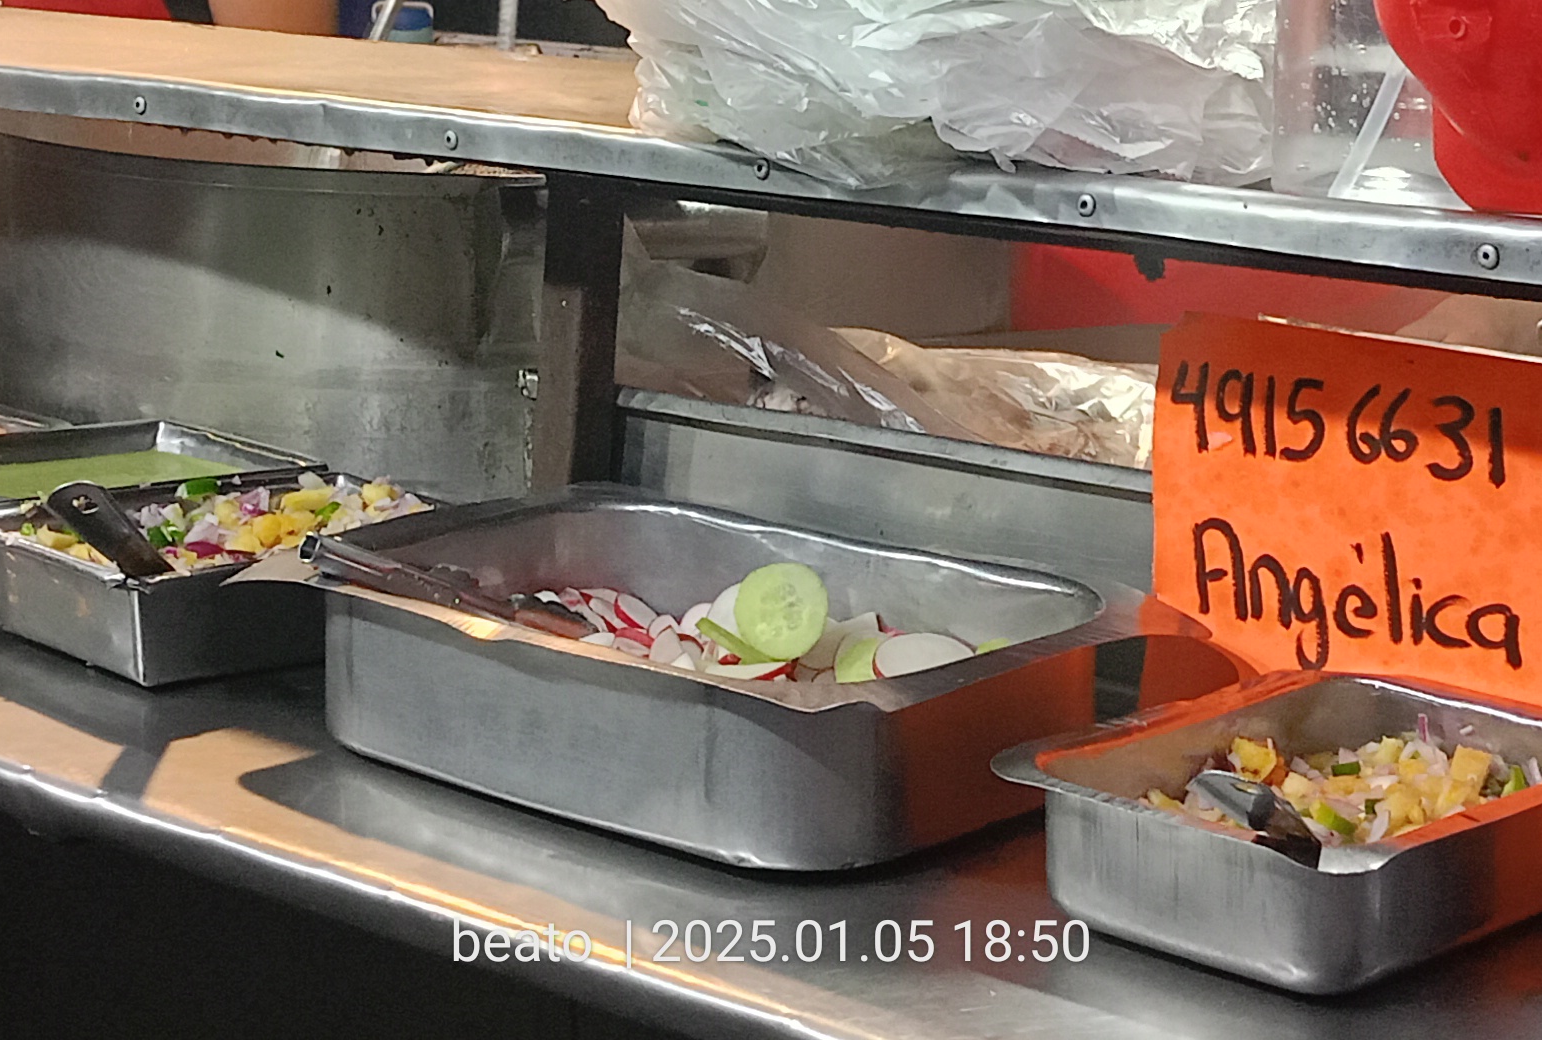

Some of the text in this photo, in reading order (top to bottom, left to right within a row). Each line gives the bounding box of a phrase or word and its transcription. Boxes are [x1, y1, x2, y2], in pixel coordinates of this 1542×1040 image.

[1171, 360, 1326, 462] 4915
[1347, 384, 1505, 489] 6631
[1192, 517, 1523, 671] Angélica
